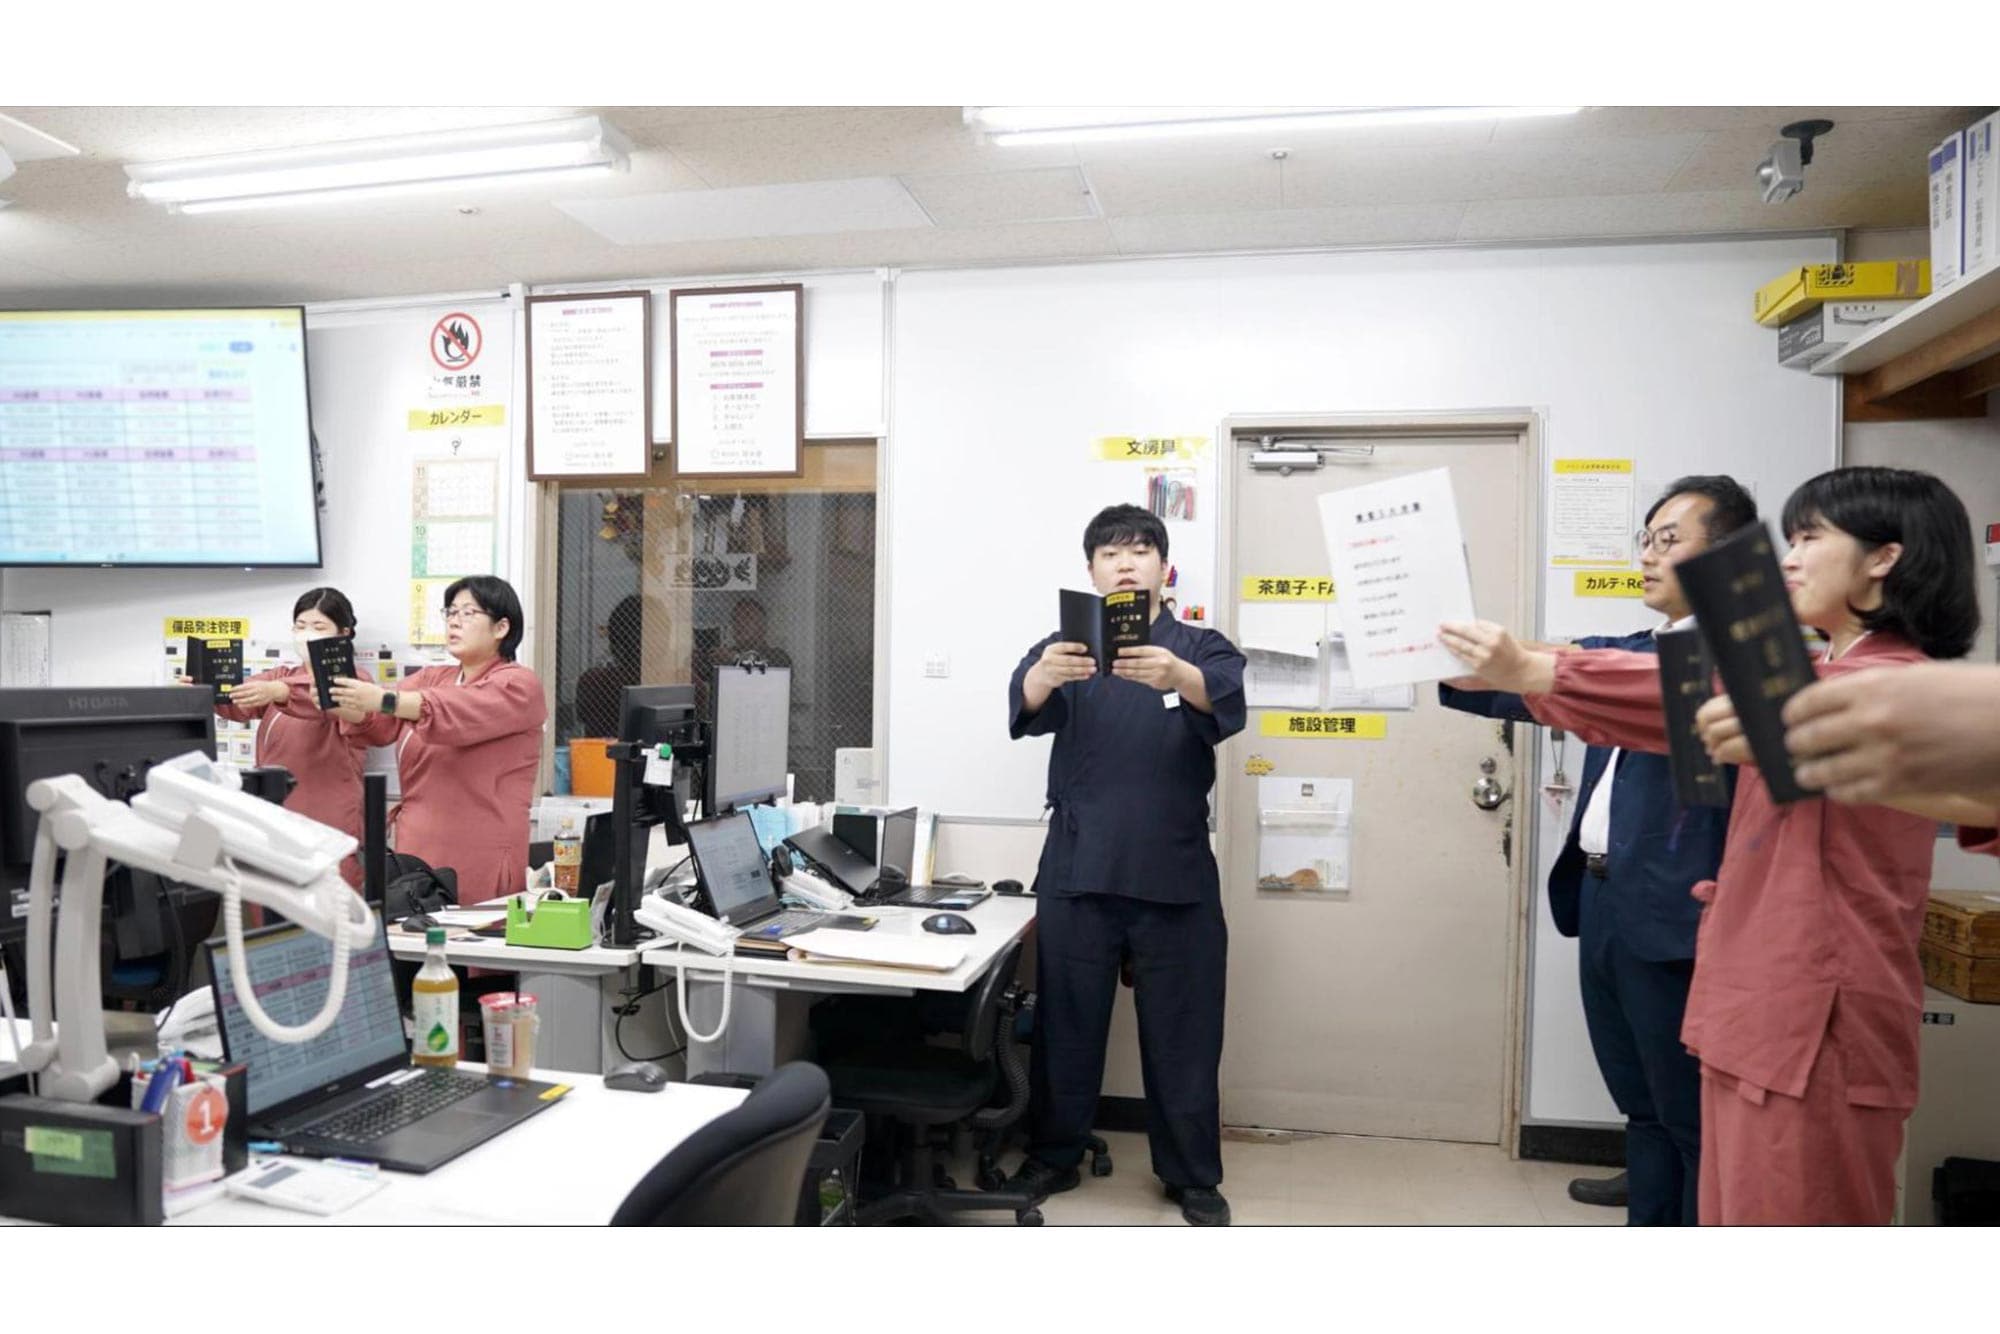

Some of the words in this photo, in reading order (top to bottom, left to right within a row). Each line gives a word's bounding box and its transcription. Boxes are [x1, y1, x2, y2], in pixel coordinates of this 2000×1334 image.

[430, 409, 482, 425] カレンダー
[1126, 439, 1176, 455] 文房具
[172, 620, 242, 635] 備品発注管理
[1289, 716, 1356, 733] 施設管理
[199, 1100, 215, 1136] 1
